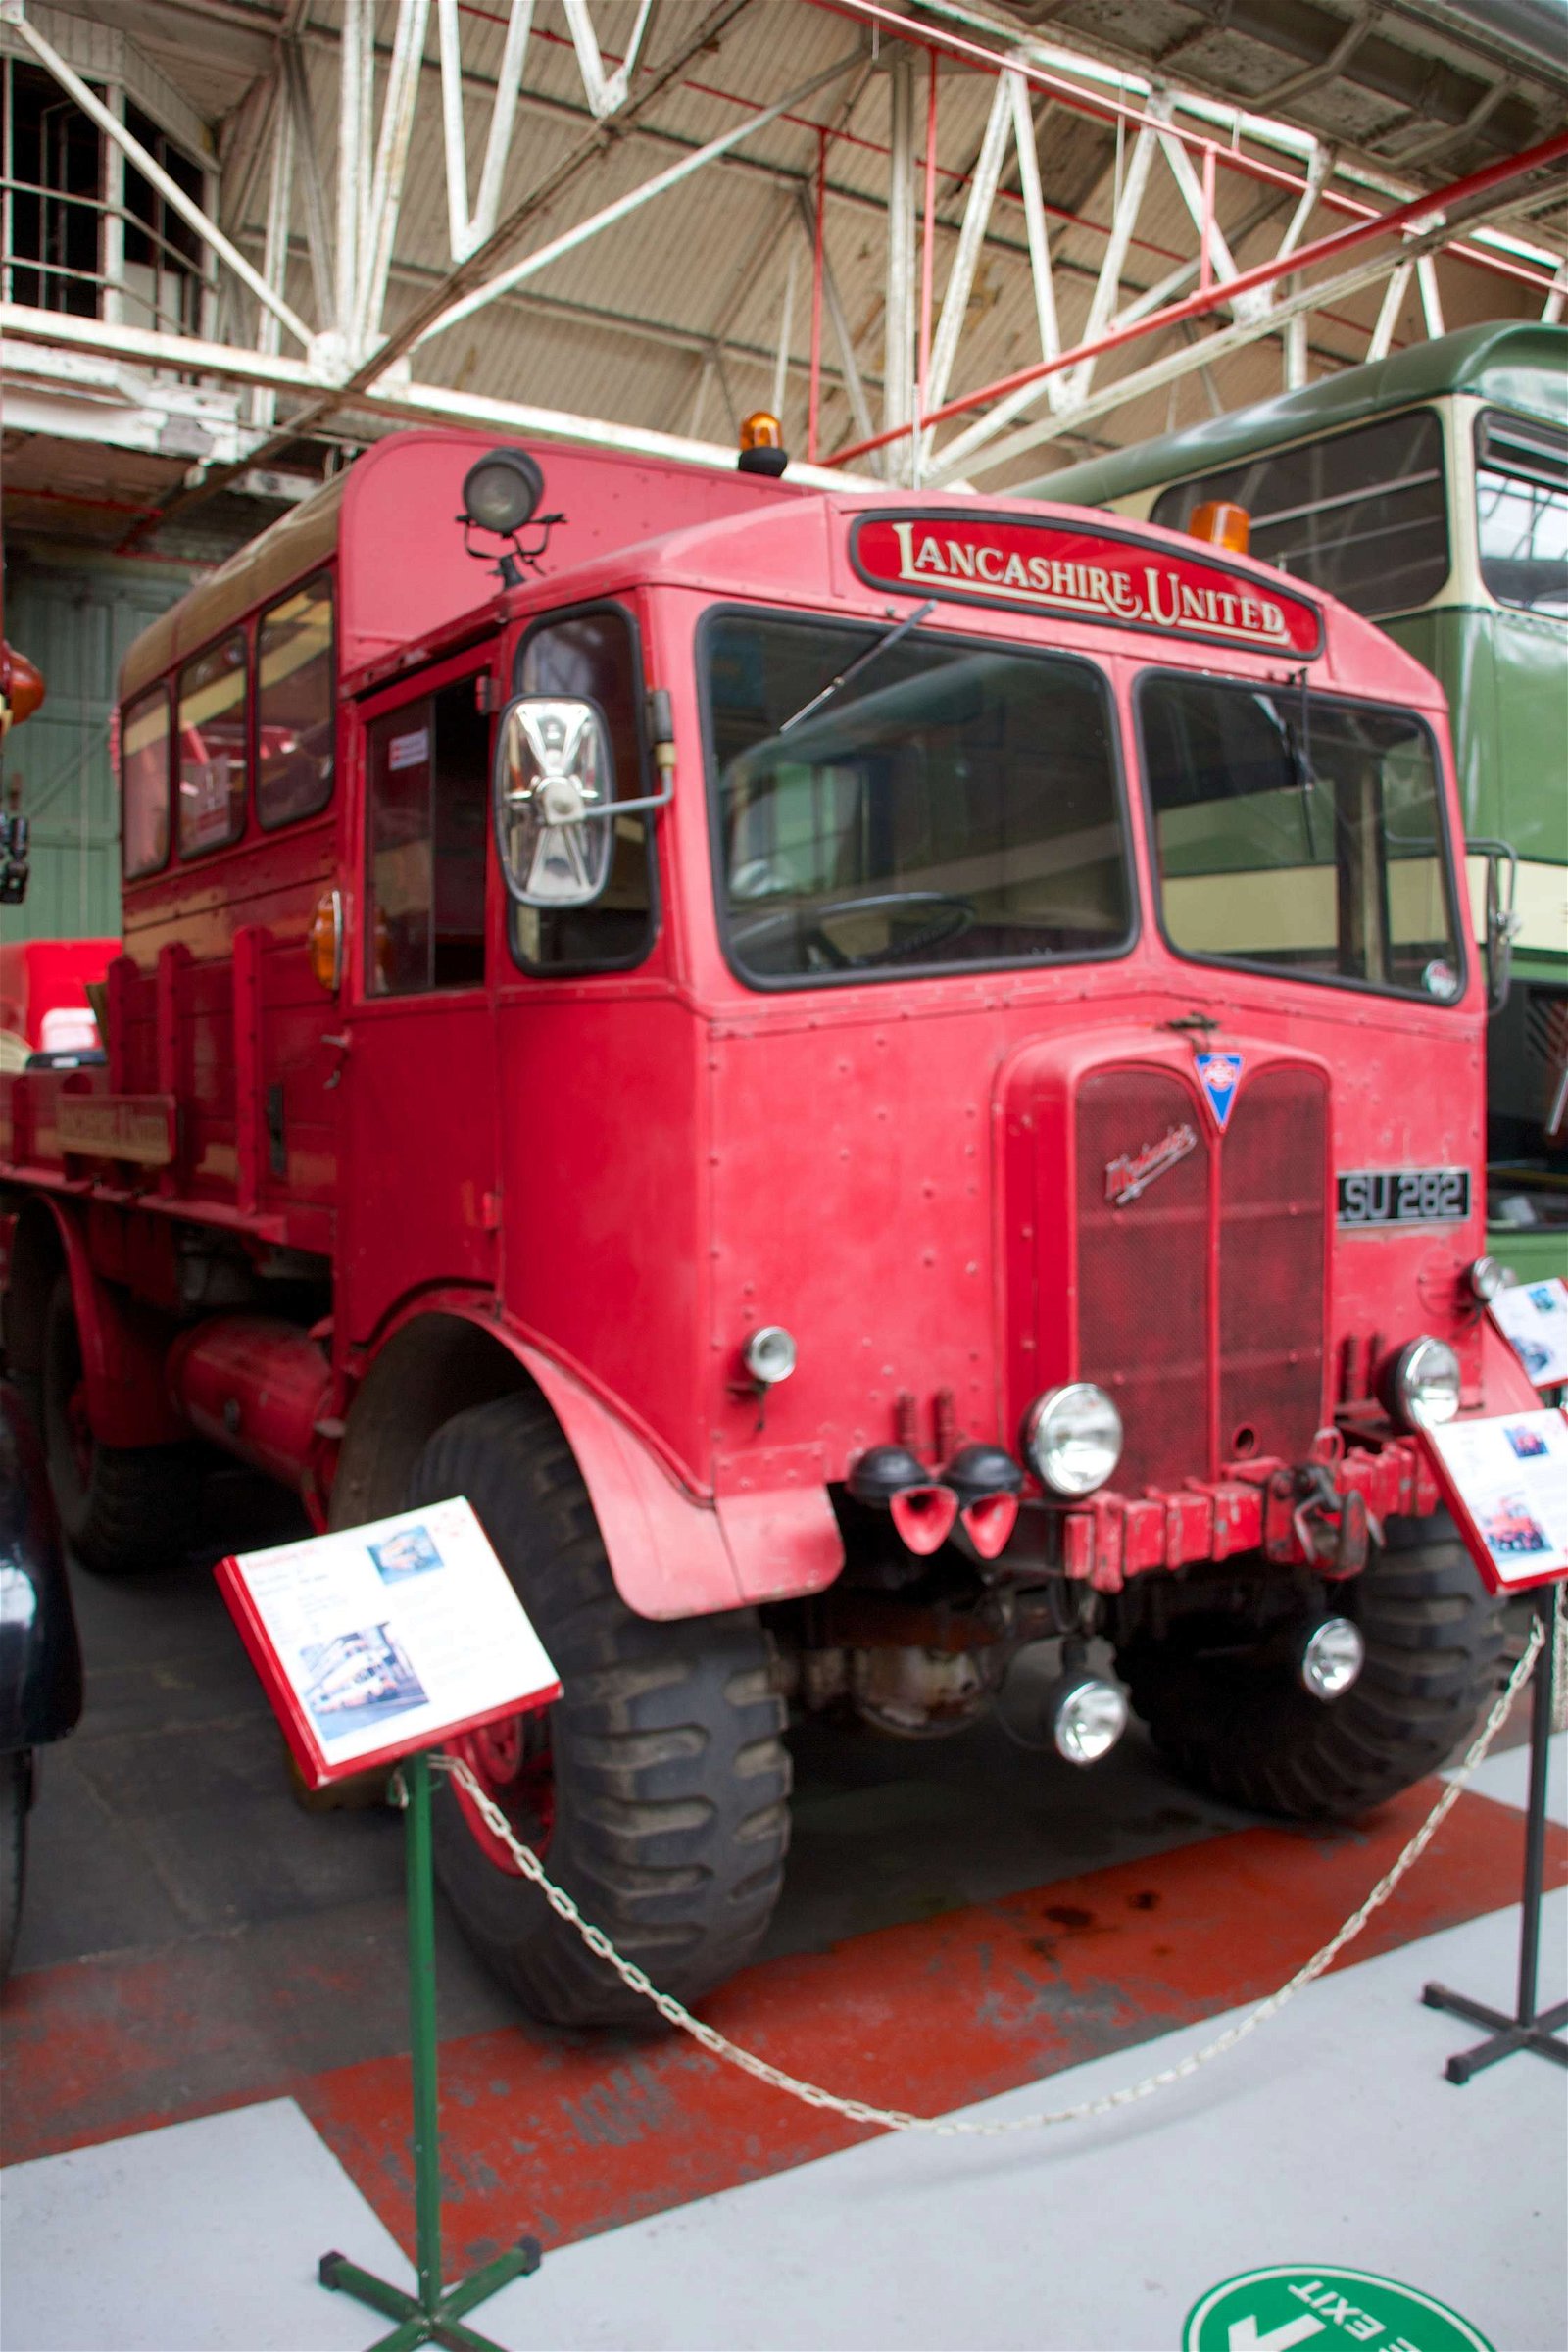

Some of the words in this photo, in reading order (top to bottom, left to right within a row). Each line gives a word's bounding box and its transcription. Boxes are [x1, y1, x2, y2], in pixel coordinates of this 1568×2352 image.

[892, 522, 1143, 618] LANCASHIRE
[1143, 567, 1289, 639] UNITED
[1338, 1175, 1391, 1221] SU
[1396, 1172, 1461, 1218] 282
[1287, 2279, 1387, 2341] EXIT
